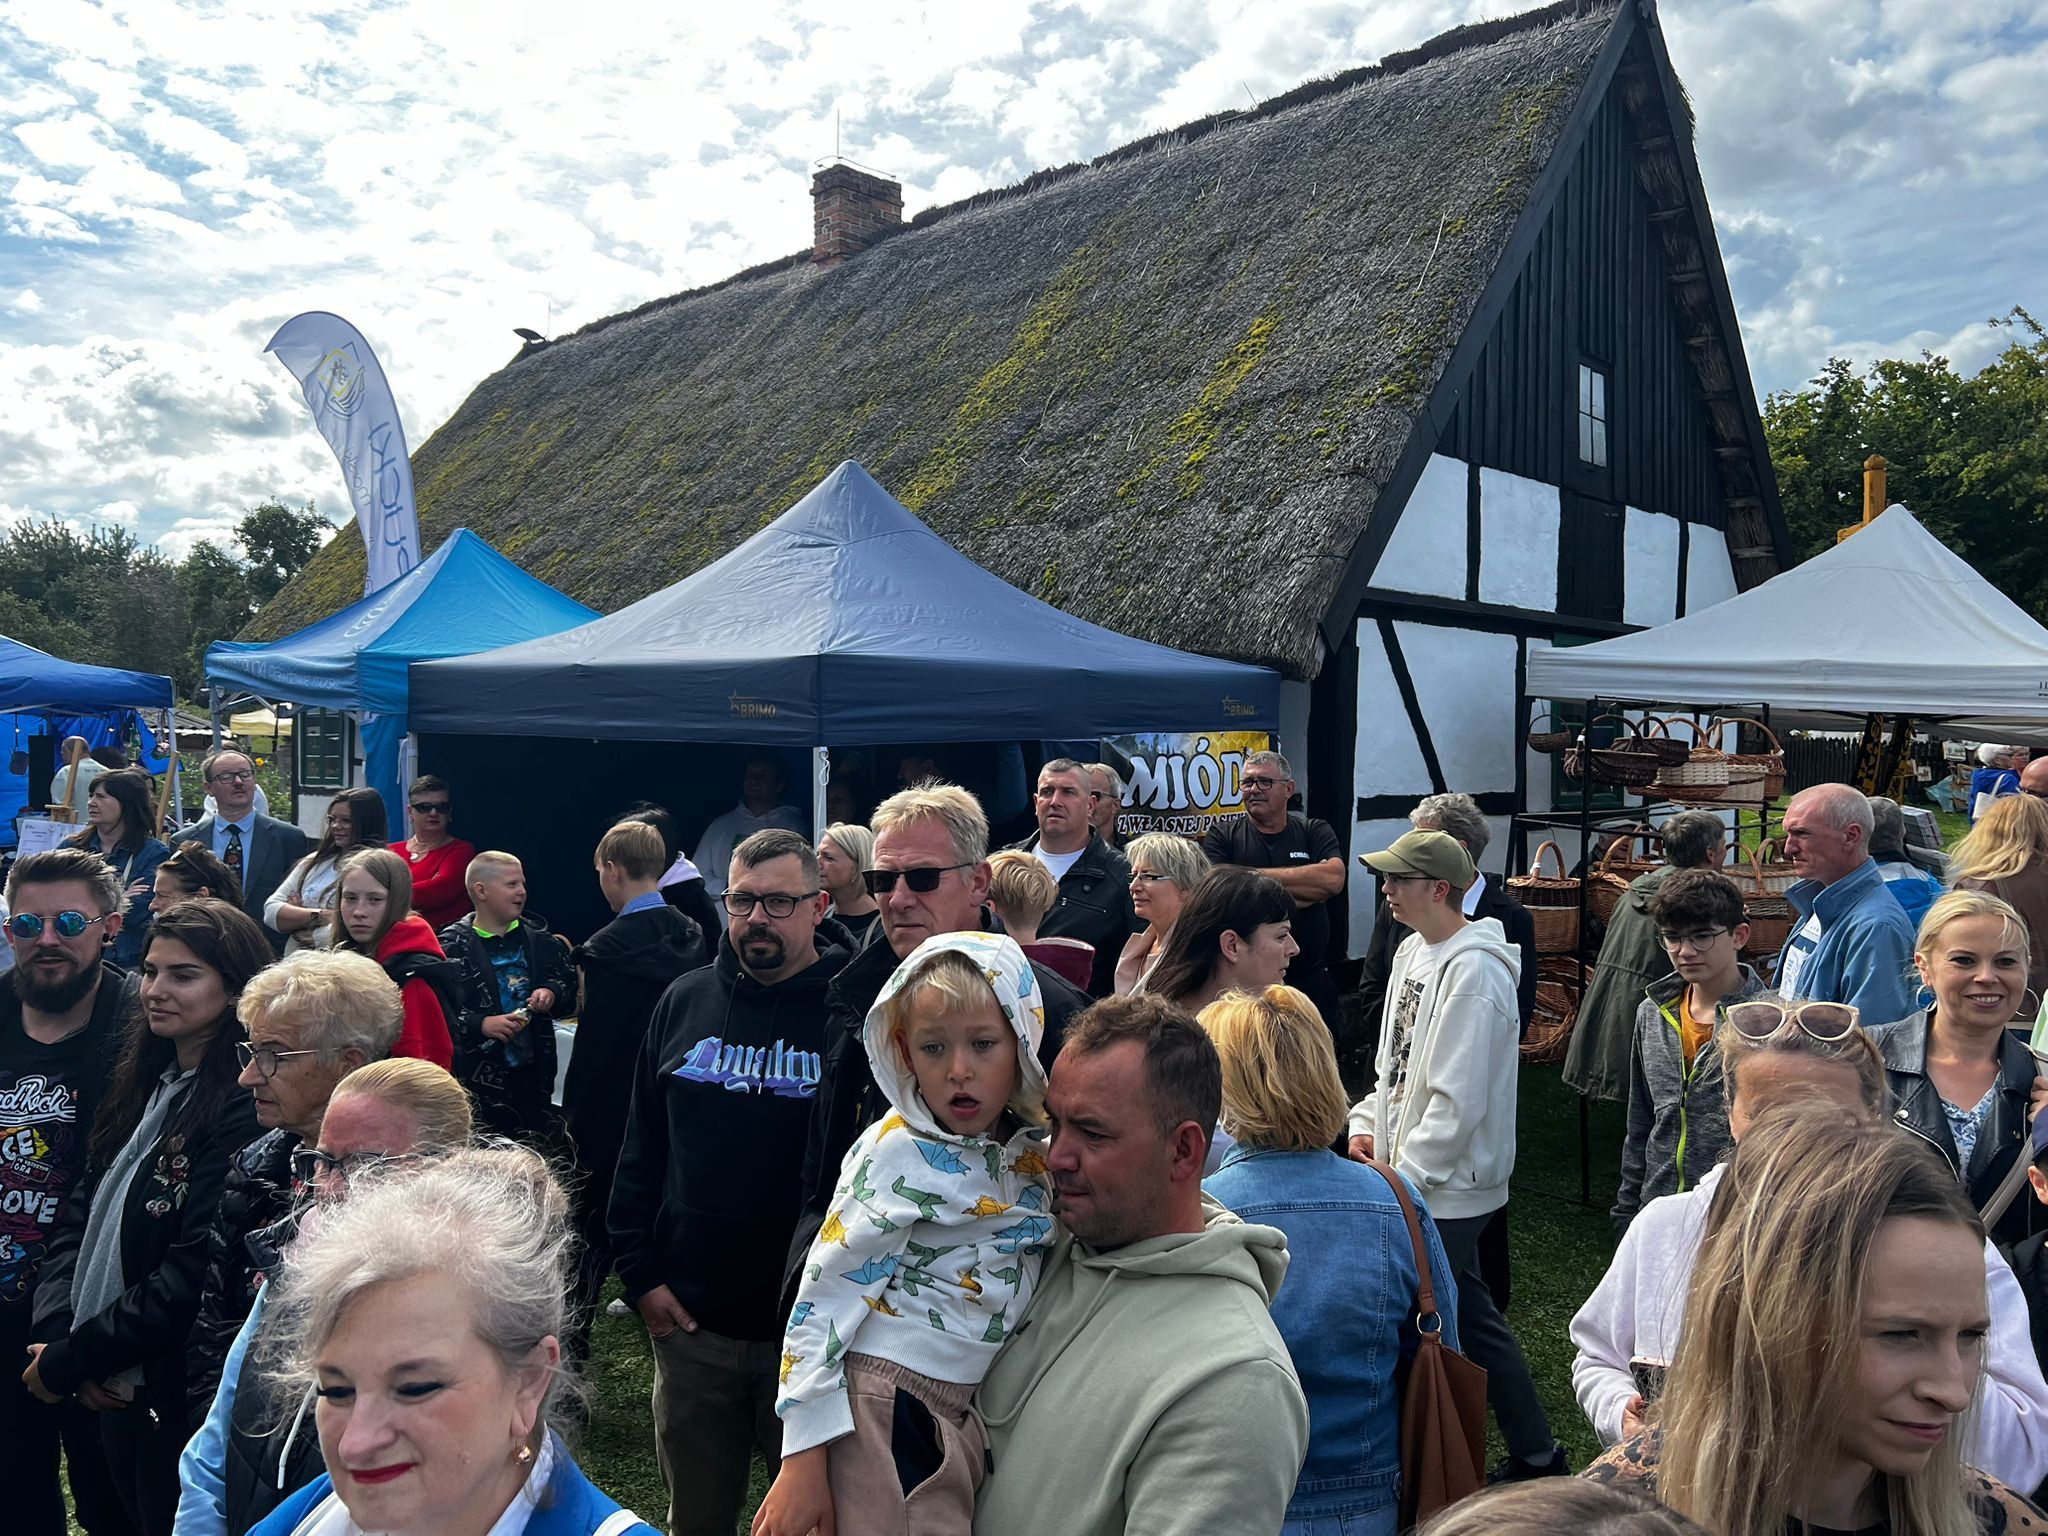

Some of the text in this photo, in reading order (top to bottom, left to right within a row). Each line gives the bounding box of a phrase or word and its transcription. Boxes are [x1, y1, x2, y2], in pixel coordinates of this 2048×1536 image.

[740, 703, 776, 718] BRIMO
[1231, 704, 1255, 716] BRIMO
[1120, 736, 1244, 811] MIÓD
[1118, 814, 1128, 834] Z
[1128, 813, 1202, 834] WŁASNEJ
[14, 1163, 31, 1174] GRA
[0, 1184, 59, 1223] OVE
